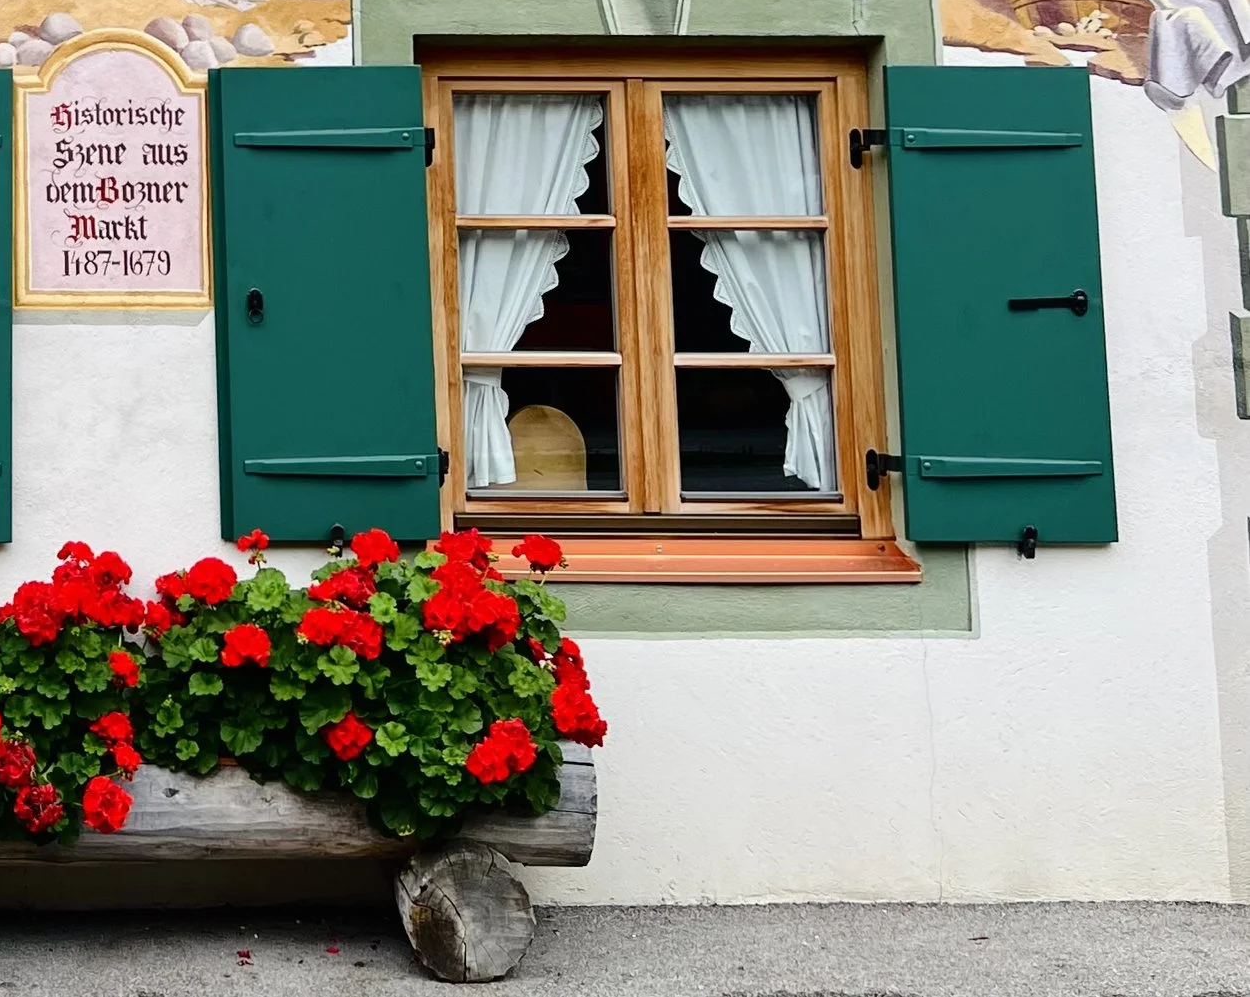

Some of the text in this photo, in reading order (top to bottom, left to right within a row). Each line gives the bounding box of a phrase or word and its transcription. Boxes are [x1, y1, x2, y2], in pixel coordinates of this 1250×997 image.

[50, 99, 185, 133] Historische
[52, 136, 189, 170] Szene aus
[45, 170, 189, 209] dem Bozner
[63, 209, 148, 245] Markt
[61, 249, 172, 277] 1487-1679
